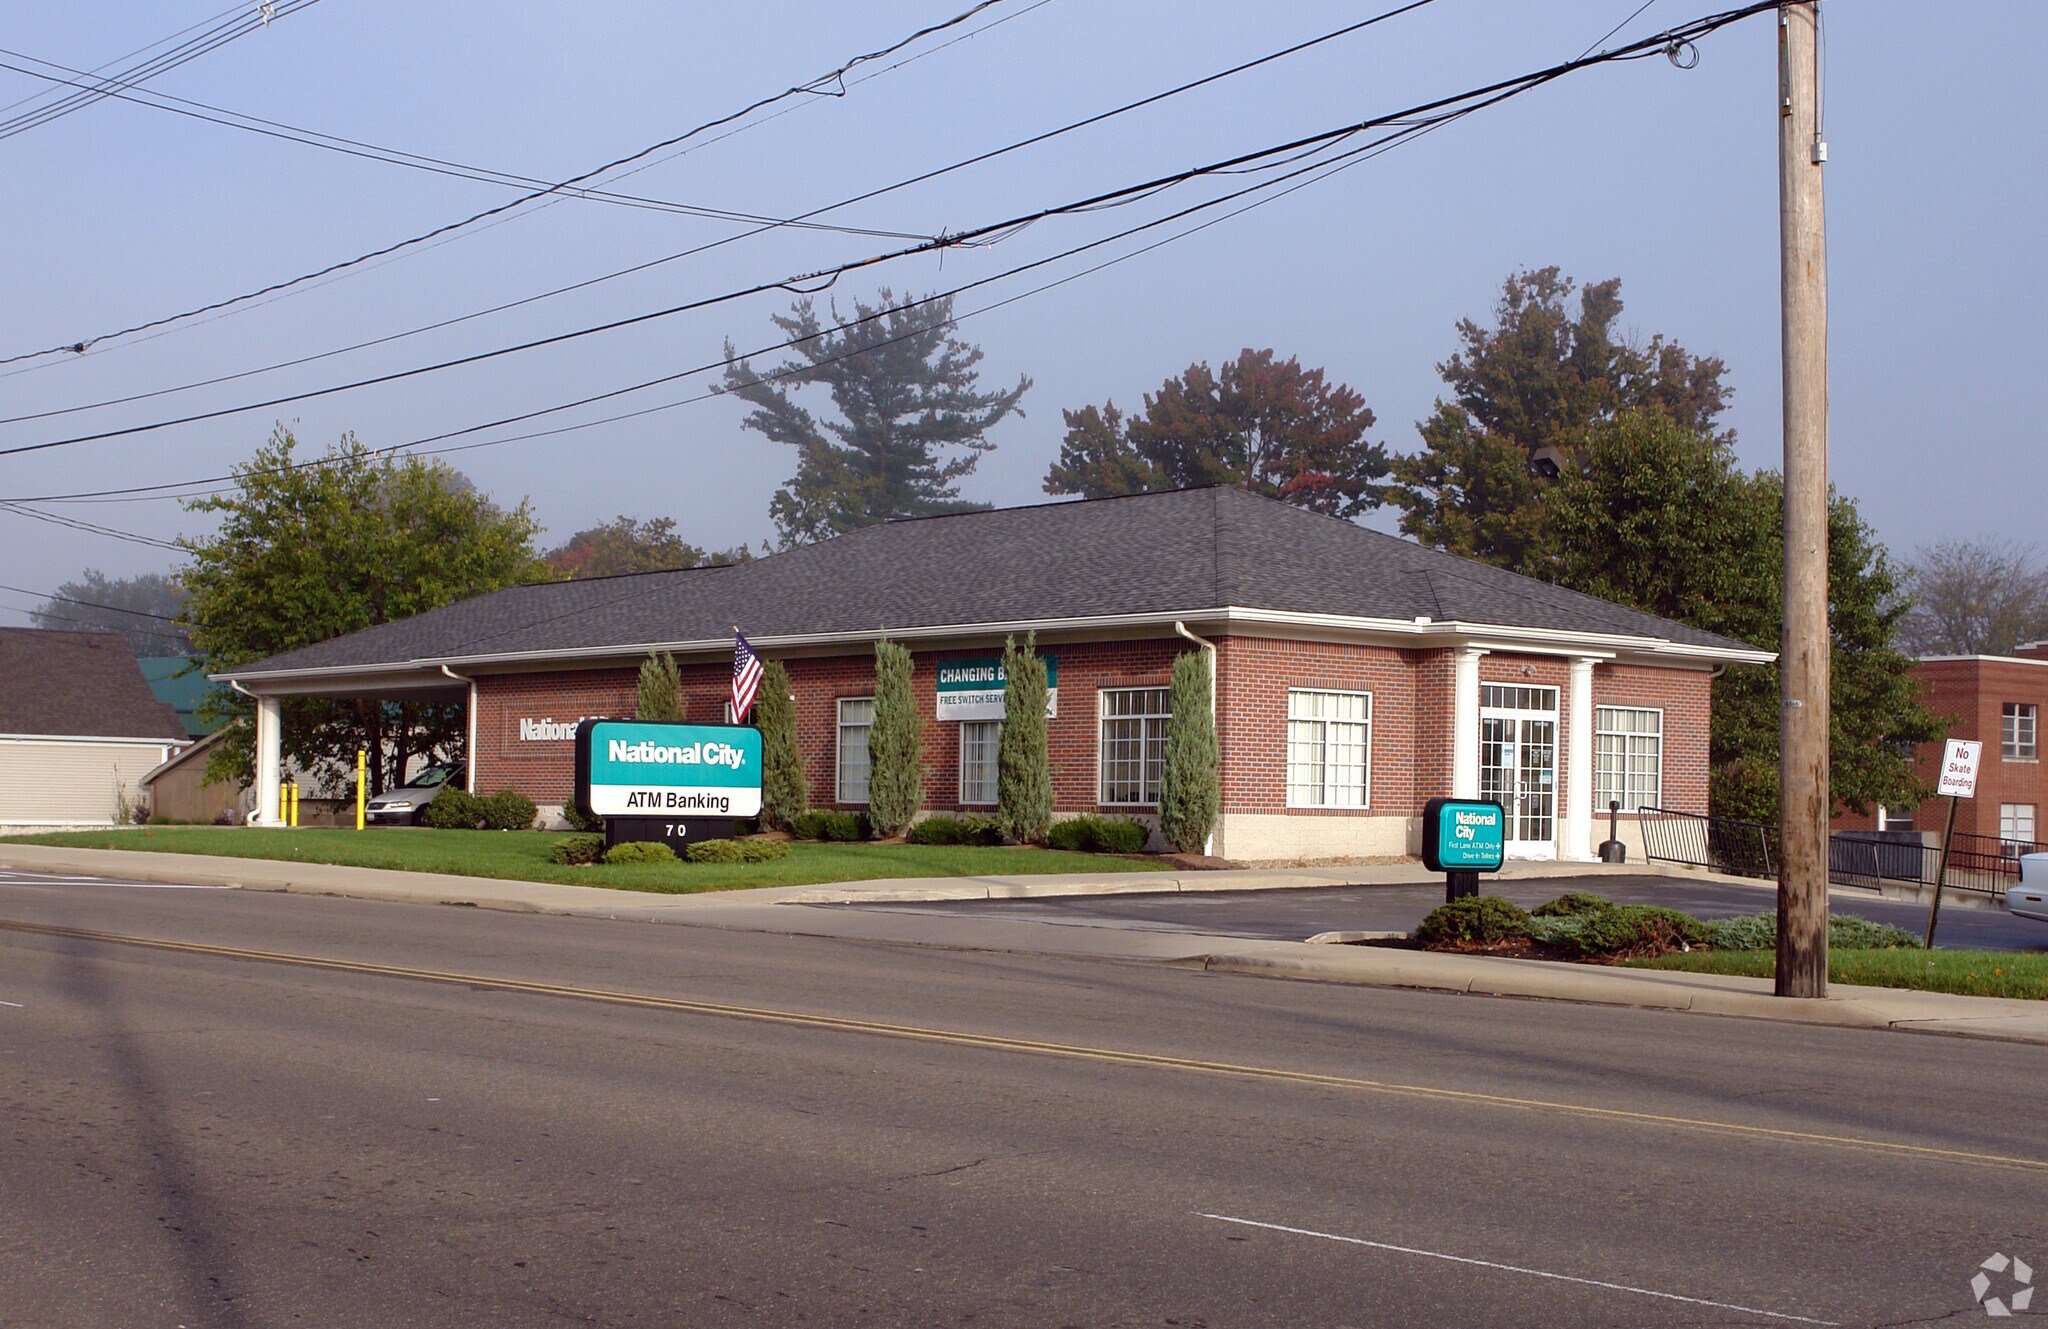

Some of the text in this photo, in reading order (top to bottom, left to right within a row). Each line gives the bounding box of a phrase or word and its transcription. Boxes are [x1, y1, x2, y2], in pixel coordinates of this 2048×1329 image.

[940, 667, 994, 683] CHANGING
[940, 694, 1006, 705] FREE SWITCH SERVI
[520, 717, 585, 741] Nationa
[609, 740, 701, 764] National
[1956, 747, 1969, 760] No
[1948, 762, 1971, 774] Skate
[1943, 776, 1972, 790] Boarding
[627, 791, 729, 813] ATM Banking
[1456, 811, 1496, 825] National
[665, 824, 687, 837] 70
[1455, 825, 1475, 841] City
[1448, 841, 1459, 849] First
